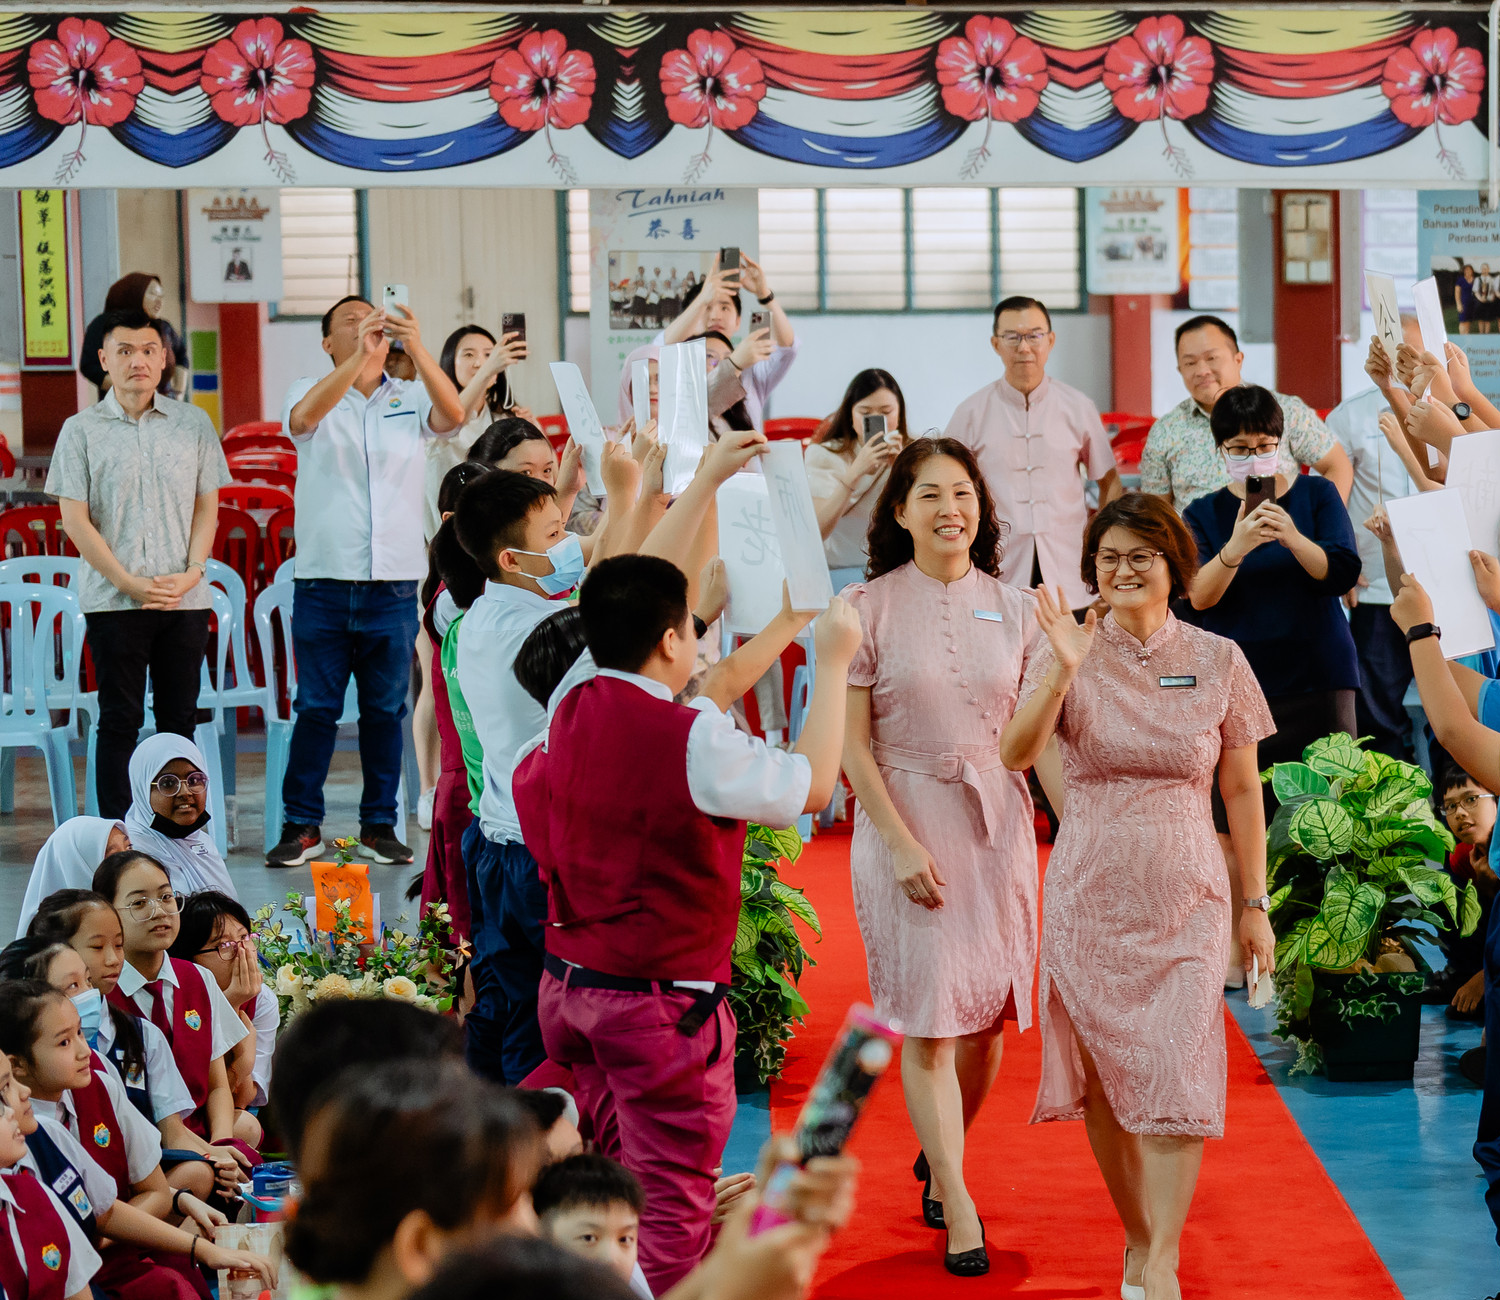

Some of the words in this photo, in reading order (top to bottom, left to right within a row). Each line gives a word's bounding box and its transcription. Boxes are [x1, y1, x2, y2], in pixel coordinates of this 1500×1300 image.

[615, 188, 725, 209] Tahniah
[645, 218, 700, 240] 恭喜
[1422, 219, 1459, 229] Bahasa
[1462, 219, 1496, 231] Melayu
[1448, 233, 1488, 243] Perdana
